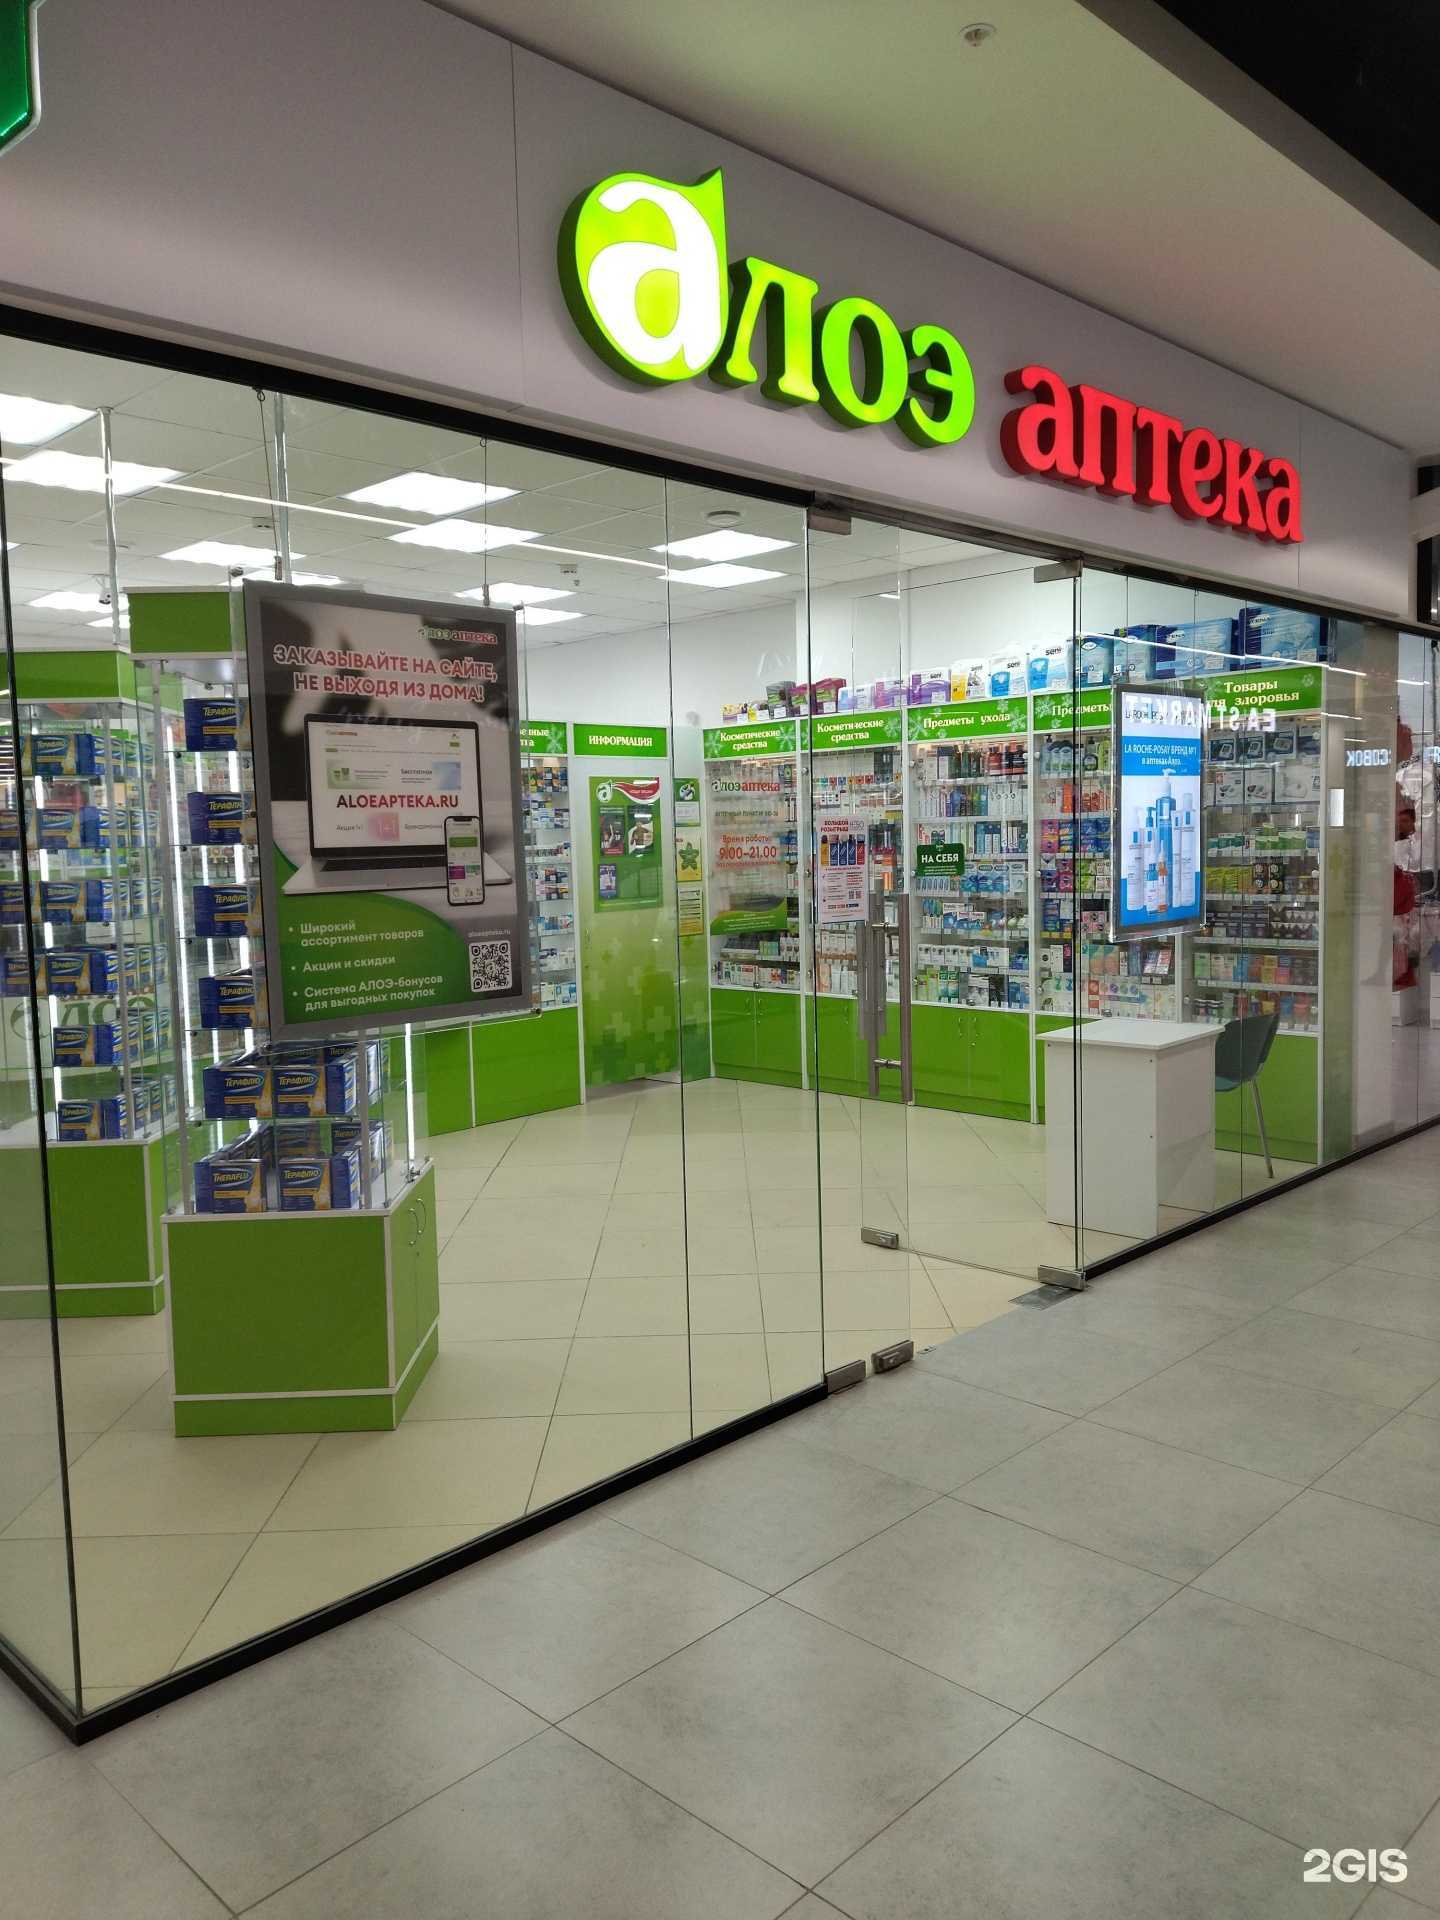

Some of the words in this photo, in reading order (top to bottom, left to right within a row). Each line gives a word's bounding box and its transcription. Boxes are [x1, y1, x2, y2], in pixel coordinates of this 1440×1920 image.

[1002, 364, 1303, 544] аптека
[274, 645, 409, 672] ЗАКАЗЫВАЙТЕ
[412, 658, 436, 674] НА
[440, 657, 497, 682] САЙТЕ,
[294, 673, 318, 691] НЕ
[323, 676, 399, 697] ВЫХОДЯ
[402, 682, 425, 698] ИЗ
[429, 684, 485, 702] ДОМА!
[1224, 681, 1278, 693] Товары
[1235, 692, 1300, 706] здоровья
[817, 717, 884, 733] Косметические
[923, 715, 974, 729] Предметы
[980, 713, 1010, 725] ухода
[588, 735, 653, 747] ИНФОРМАЦИЯ
[720, 729, 781, 743] Косметические
[830, 731, 870, 743] средства
[732, 740, 768, 751] средства
[336, 794, 459, 808] ALOEAPTEKA.RU
[921, 854, 935, 863] НА
[936, 853, 959, 863] СЕБЯ
[300, 920, 356, 934] Широкий
[301, 934, 377, 947] ассортимент
[379, 929, 424, 943] товаров
[303, 960, 342, 973] Акции
[344, 960, 352, 969] и
[353, 955, 396, 969] скидки
[304, 984, 357, 998] Система
[359, 975, 443, 992] АЛОЭ-бонусов
[305, 1000, 328, 1012] для
[330, 994, 388, 1011] выгодных
[390, 988, 435, 1003] покупок
